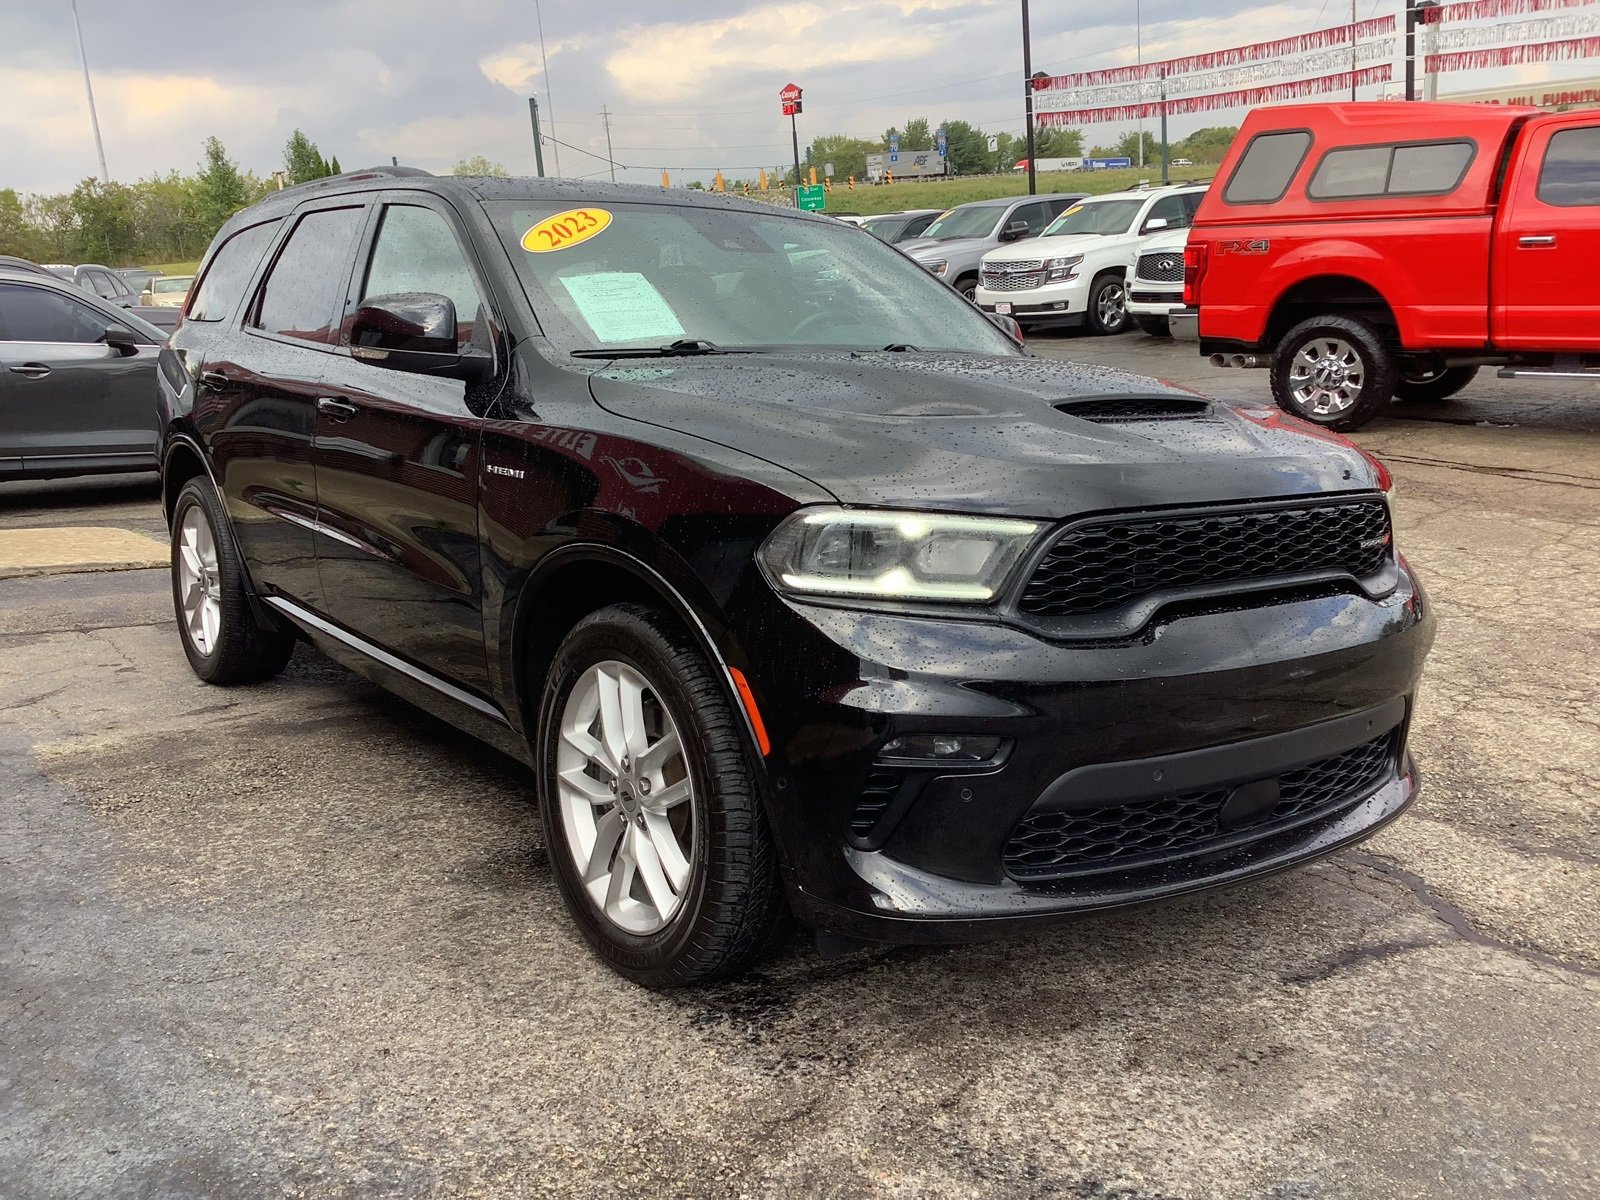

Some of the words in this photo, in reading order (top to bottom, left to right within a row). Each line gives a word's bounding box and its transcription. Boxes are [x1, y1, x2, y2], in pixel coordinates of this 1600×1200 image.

[538, 211, 598, 247] 2023
[1215, 240, 1269, 255] FX4
[487, 464, 525, 479] HEMI
